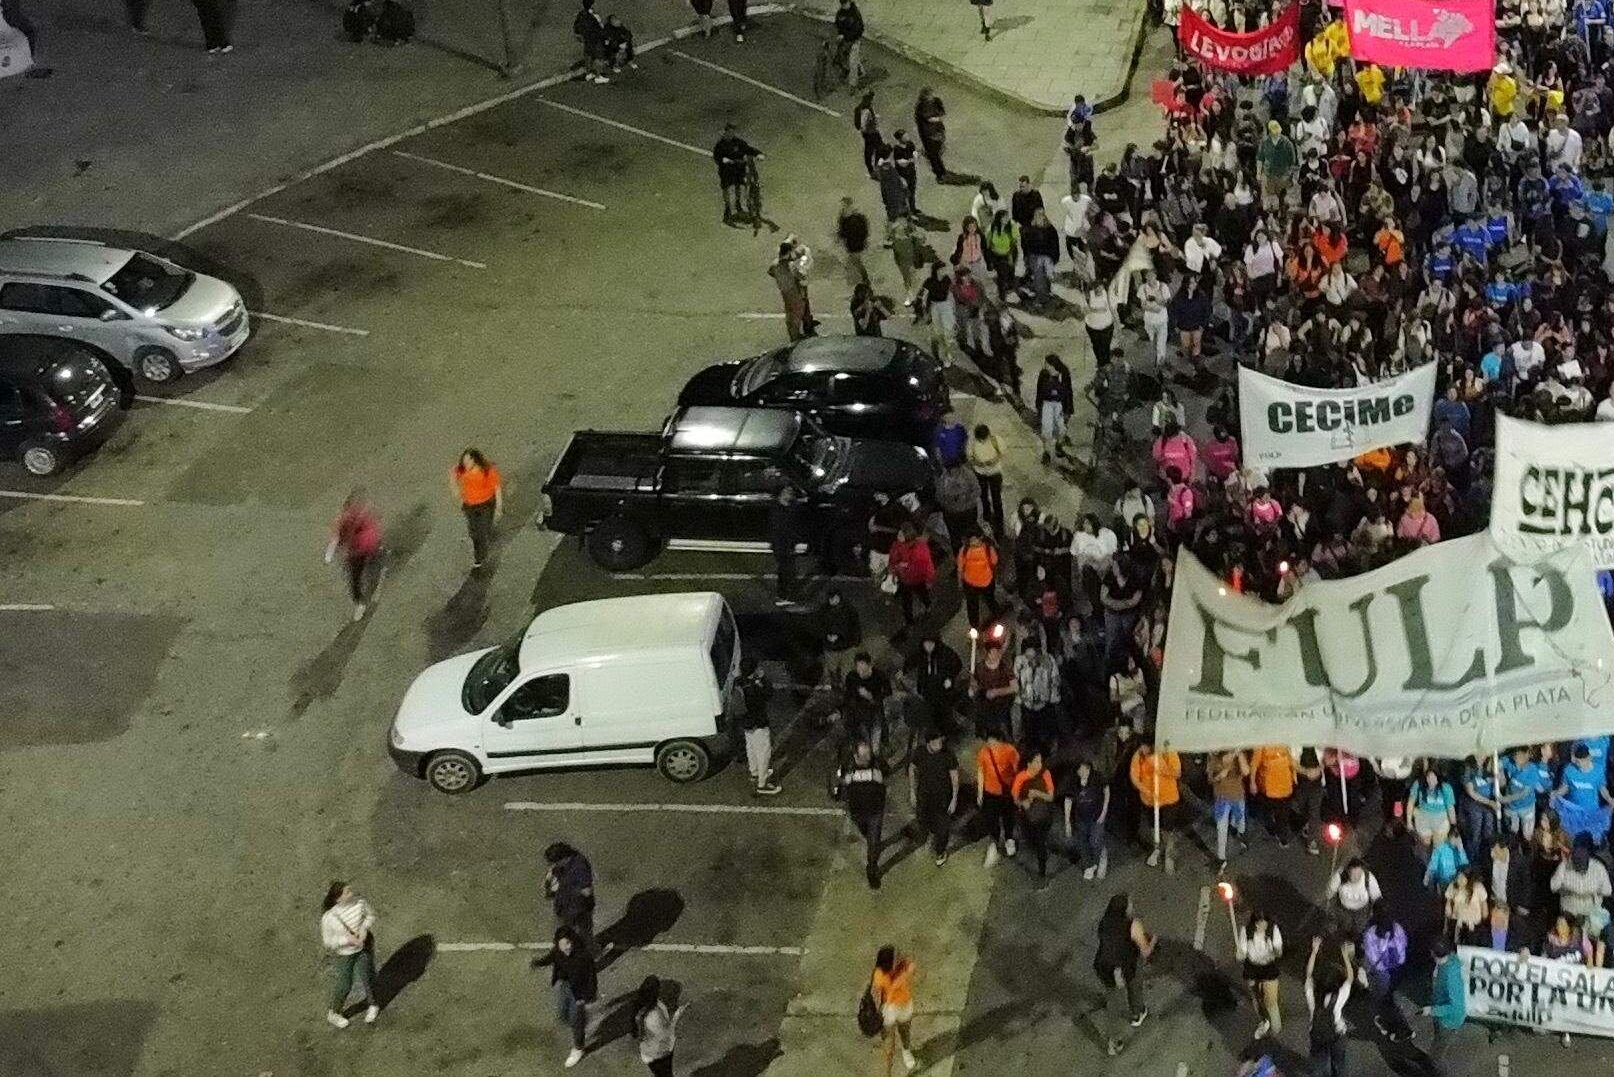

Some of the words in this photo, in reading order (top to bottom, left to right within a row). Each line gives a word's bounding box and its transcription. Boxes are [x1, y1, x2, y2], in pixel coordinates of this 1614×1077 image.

[1188, 559, 1576, 700] FULP
[1512, 685, 1571, 713] PLATA
[1470, 955, 1520, 984] POR
[1468, 975, 1525, 1005] POR
